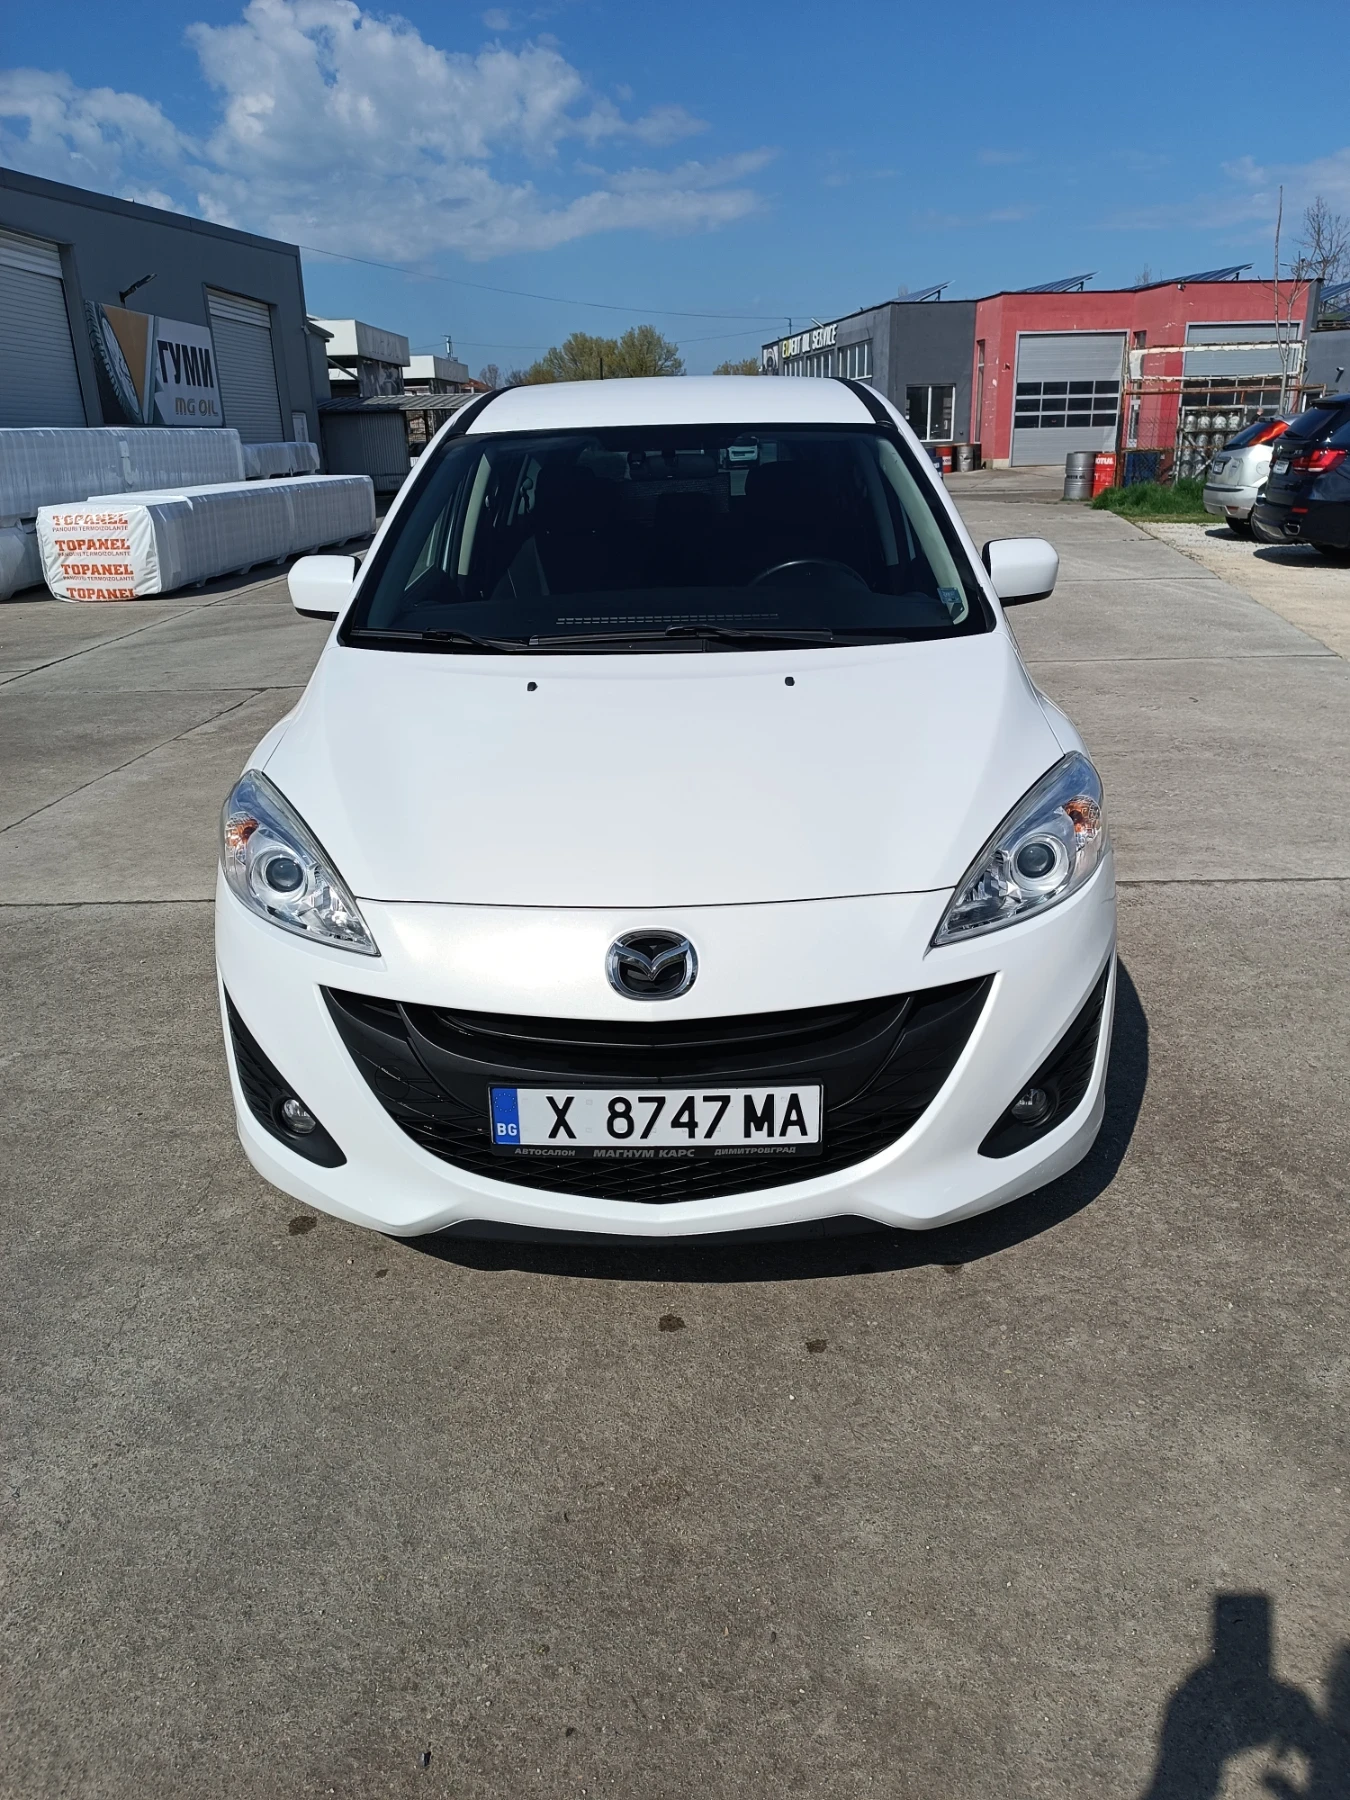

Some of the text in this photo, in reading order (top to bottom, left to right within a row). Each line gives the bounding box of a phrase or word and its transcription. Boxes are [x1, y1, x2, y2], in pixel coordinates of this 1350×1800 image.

[812, 324, 838, 350] SERVICE
[157, 340, 214, 388] ГУМИ
[175, 397, 219, 417] MG OIL
[52, 513, 128, 526] TOPANEL
[55, 538, 130, 551] TOPANEL
[61, 564, 134, 576] TOPANEL
[66, 588, 138, 600] TOPANEL
[606, 1096, 731, 1139] 8747
[743, 1093, 808, 1138] MA
[497, 1123, 518, 1136] BG
[515, 1147, 796, 1158] АВТОСАЛОН МАГНУМ КАРС ДИМИТРОВГРАД
